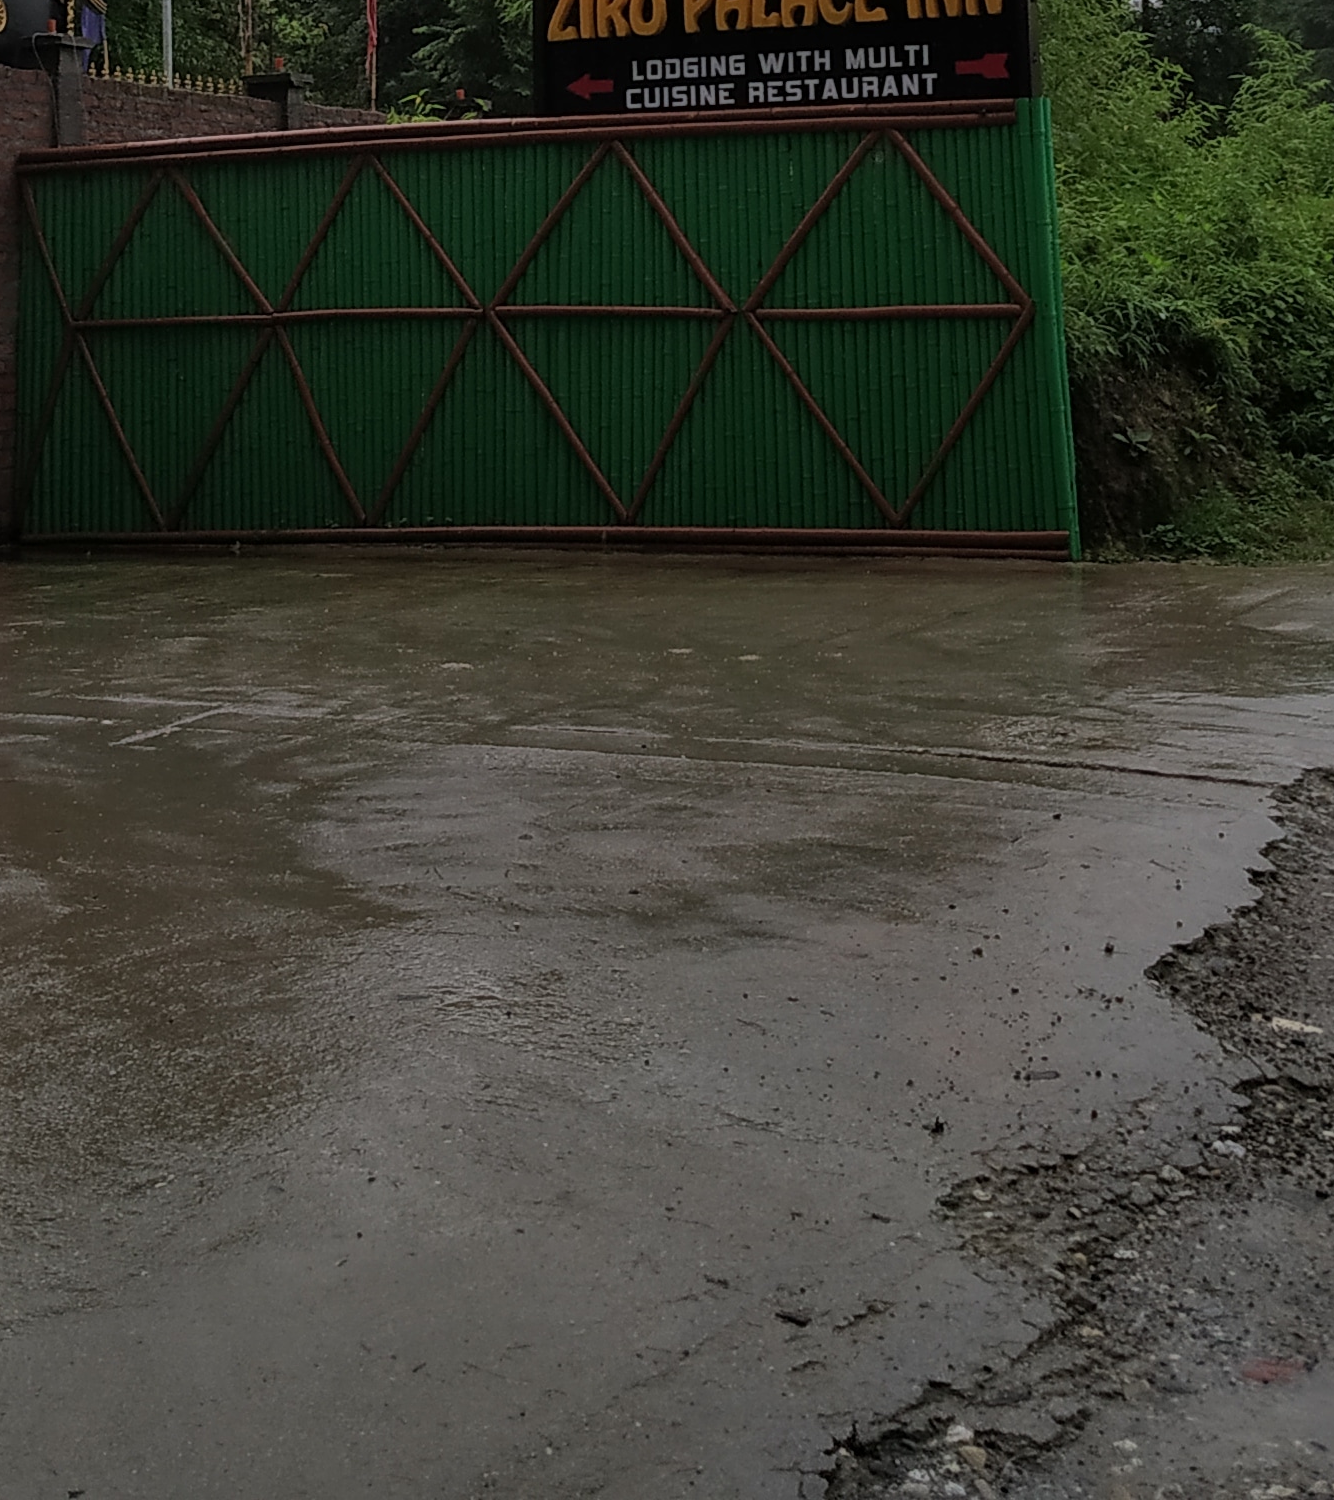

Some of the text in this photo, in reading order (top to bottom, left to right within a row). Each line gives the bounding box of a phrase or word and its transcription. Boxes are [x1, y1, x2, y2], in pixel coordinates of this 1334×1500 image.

[631, 44, 930, 81] LODGING WITH MULTI
[625, 73, 939, 109] CUISINE RESTAURANT
